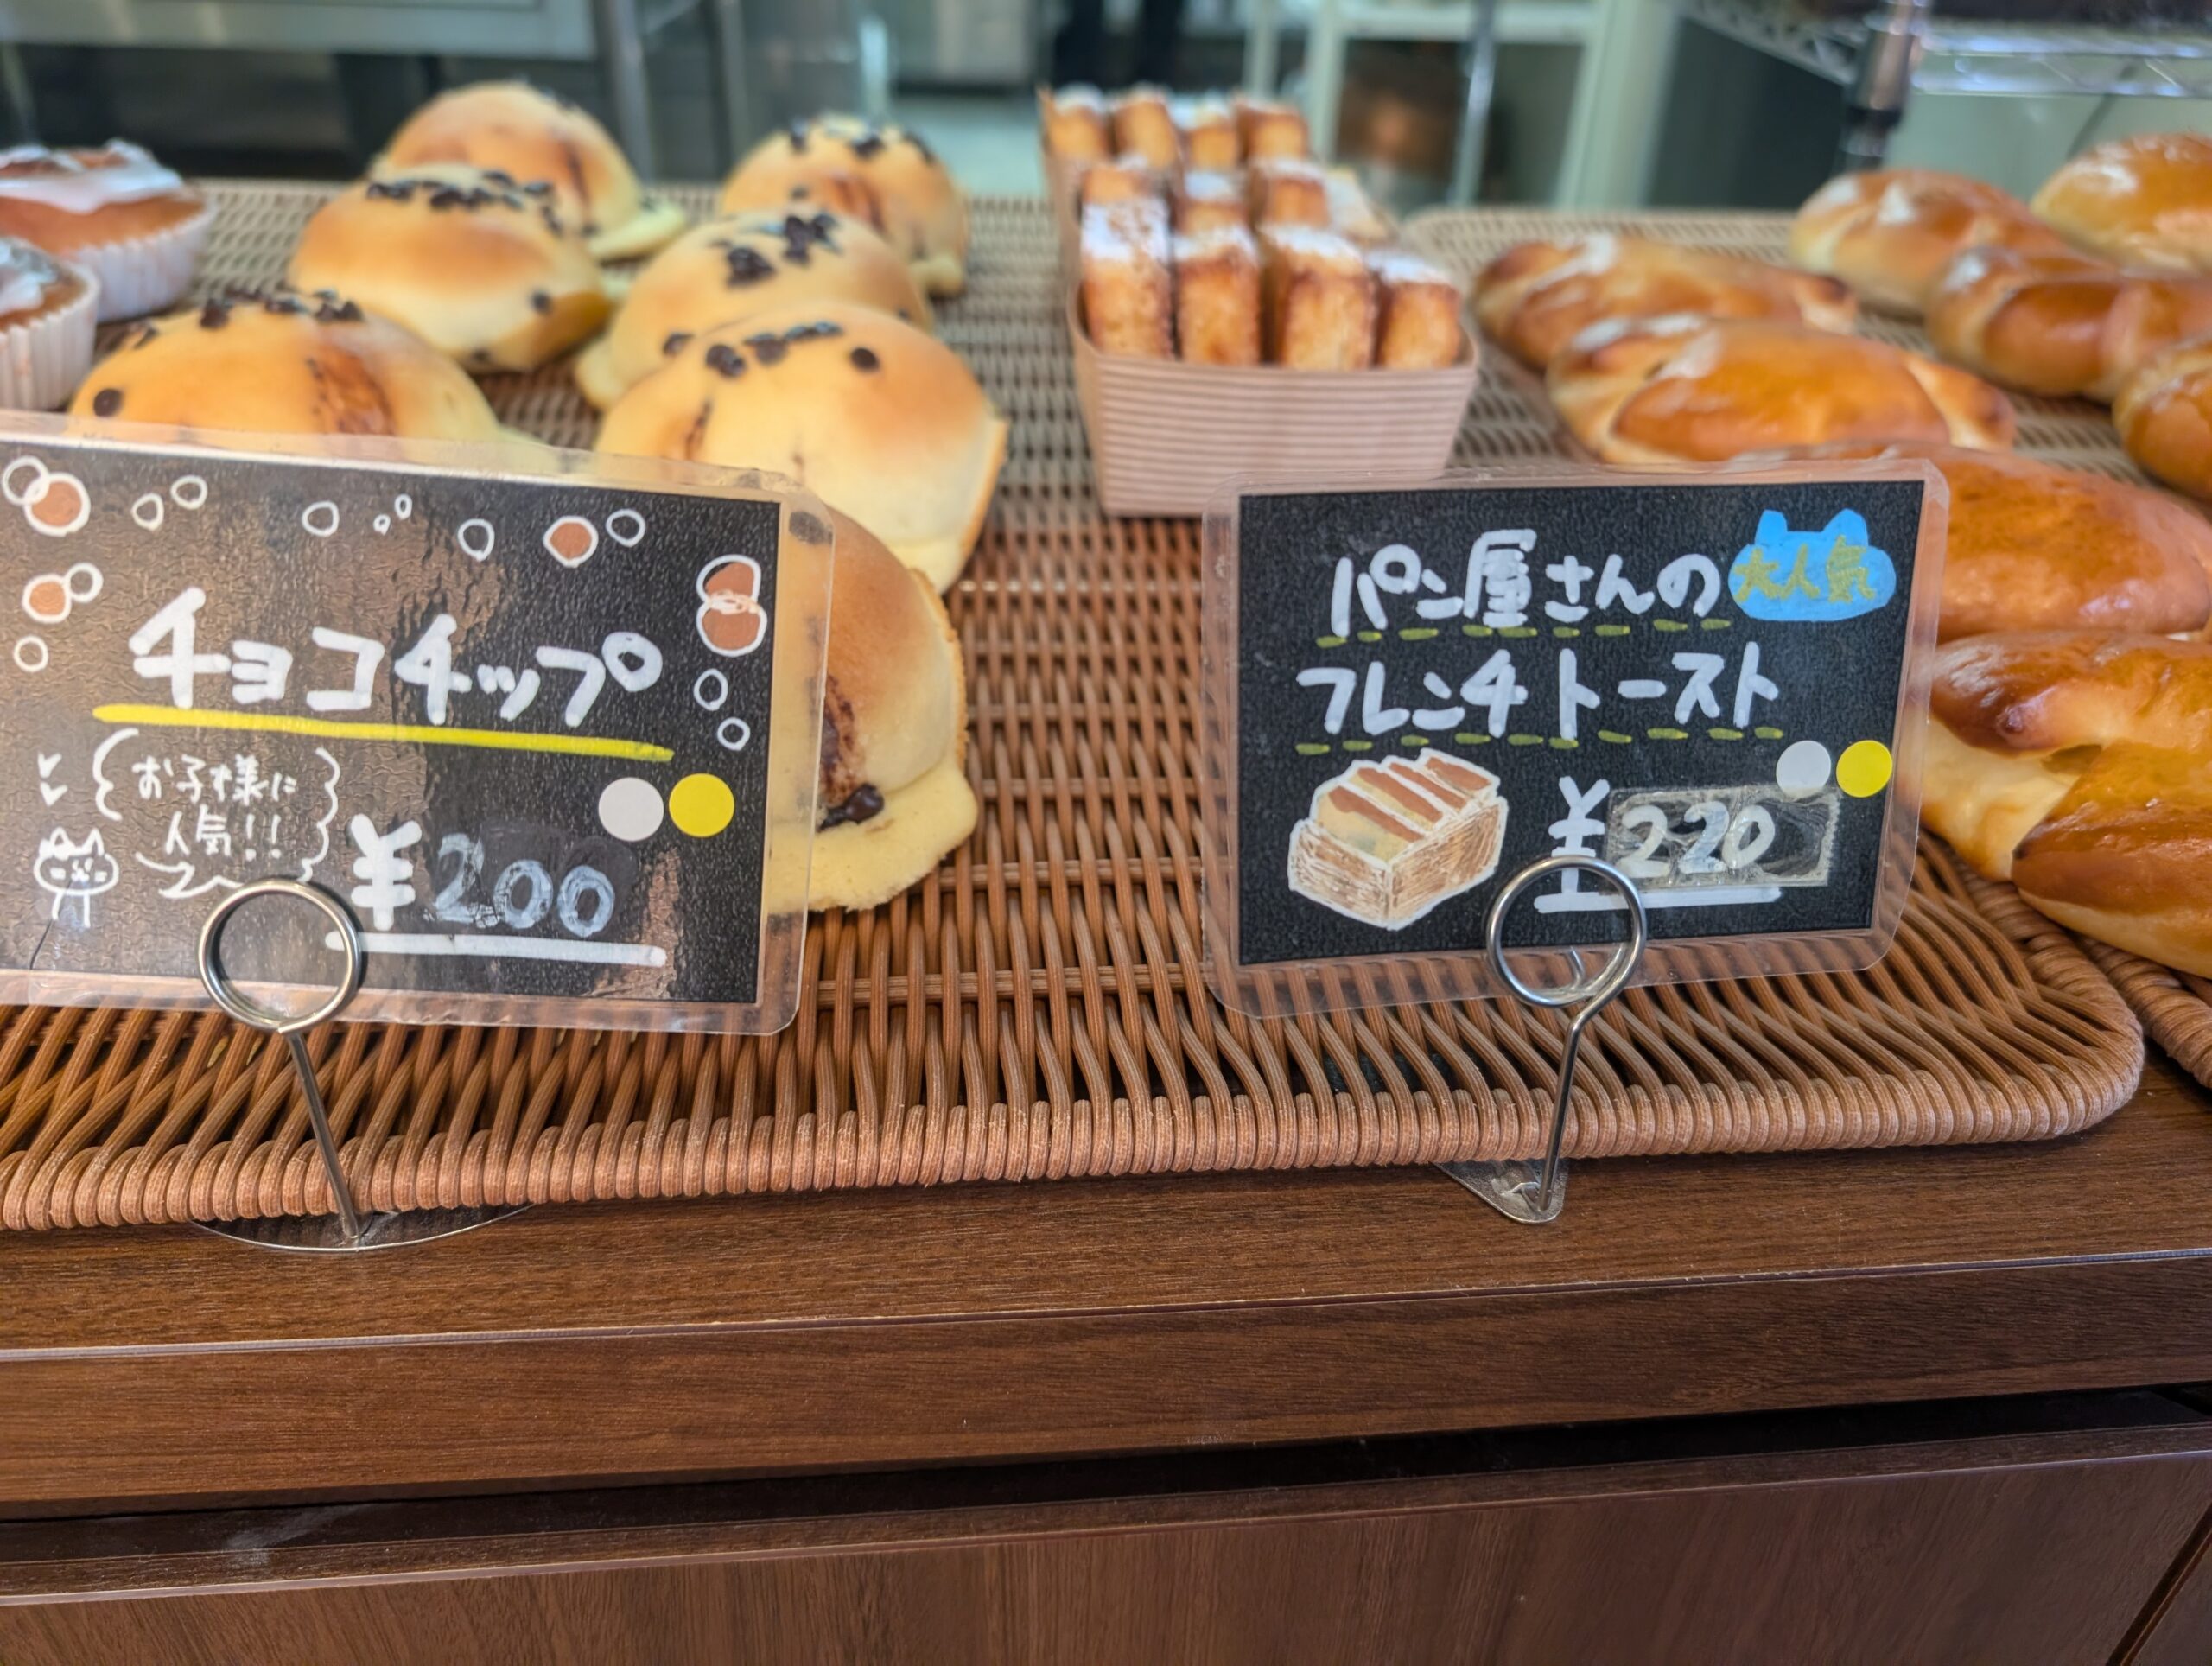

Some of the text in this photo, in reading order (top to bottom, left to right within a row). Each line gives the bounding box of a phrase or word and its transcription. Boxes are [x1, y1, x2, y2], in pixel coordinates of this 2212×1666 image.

[1331, 528, 1721, 637] パン屋さんの
[1732, 534, 1876, 602] 大人気
[129, 588, 662, 727] チョコチップ
[1297, 641, 1779, 740] フレンチトースト
[132, 754, 296, 804] お子様に
[351, 814, 615, 938] ¥200
[1548, 777, 1776, 893] ¥220
